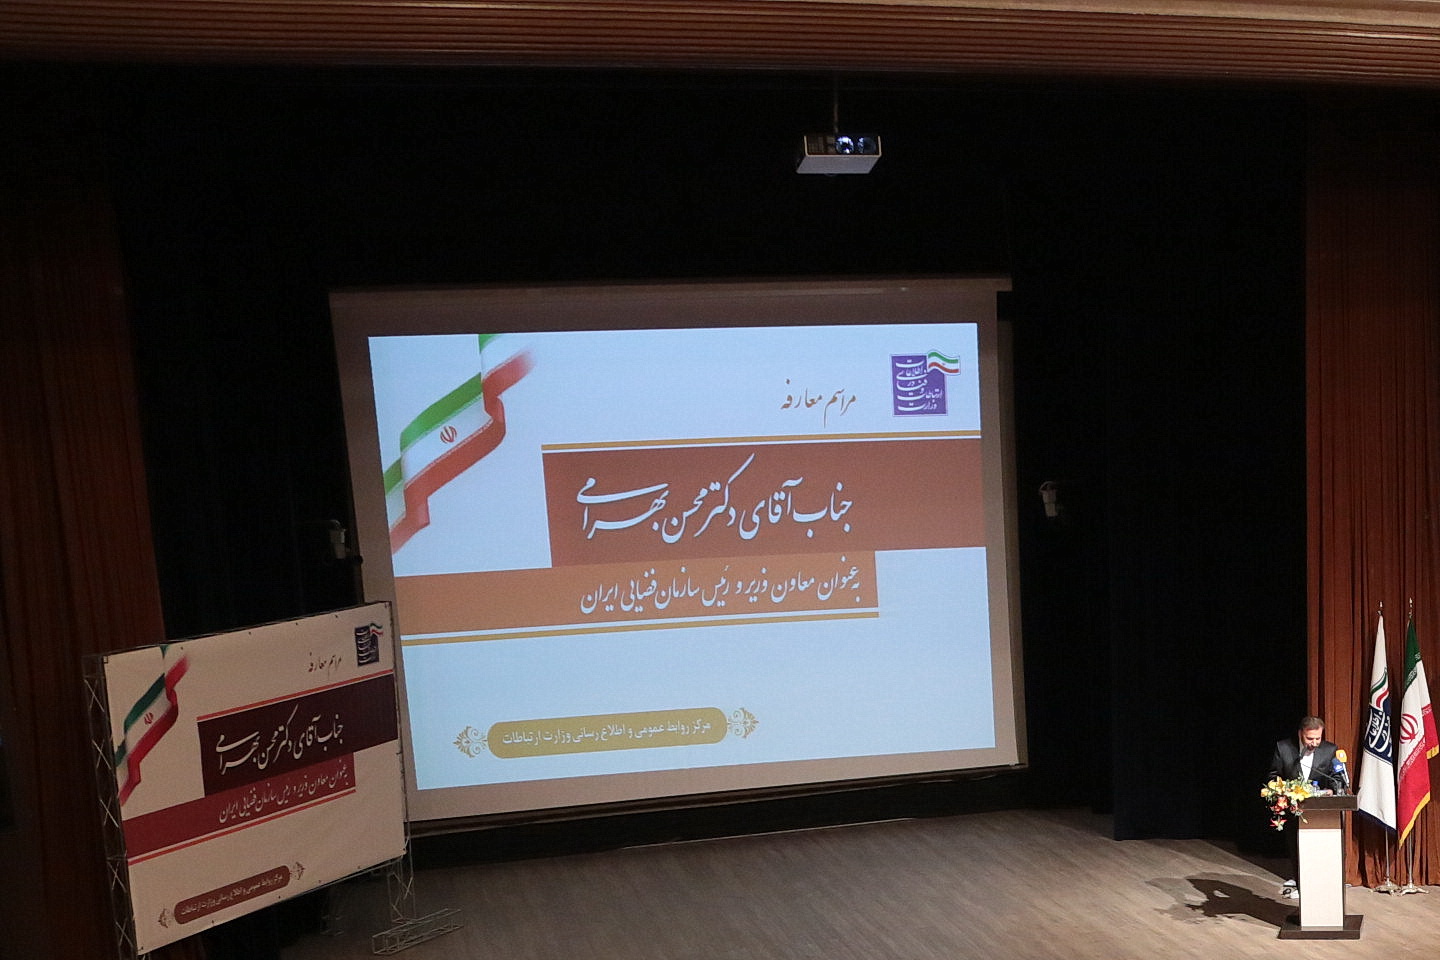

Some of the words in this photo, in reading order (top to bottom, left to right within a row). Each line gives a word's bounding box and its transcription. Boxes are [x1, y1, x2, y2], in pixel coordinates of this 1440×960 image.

[780, 378, 823, 410] معارفه
[823, 388, 857, 429] مراسم
[576, 477, 670, 540] بهرامی
[694, 452, 755, 538] دکتر
[739, 477, 803, 540] آقای
[792, 482, 853, 539] جناب
[662, 487, 708, 544] محسن
[580, 582, 619, 614] ایران
[620, 568, 658, 613] فضایی
[654, 566, 701, 610] سازمان
[701, 565, 731, 607] رئیس
[735, 580, 743, 595] و
[745, 567, 769, 603] وزیر
[770, 571, 815, 603] معاون
[273, 703, 299, 764] دکتر
[293, 714, 322, 760] آقای
[317, 714, 344, 752] جناب
[502, 731, 541, 746] ارتباطات
[544, 729, 572, 744] وزارت
[573, 727, 600, 743] رسانی
[601, 724, 626, 741] اطلاع
[628, 729, 633, 739] و
[635, 724, 665, 739] عمومی
[667, 720, 690, 736] روابط
[693, 718, 712, 734] مرکز
[257, 731, 279, 770] محسن
